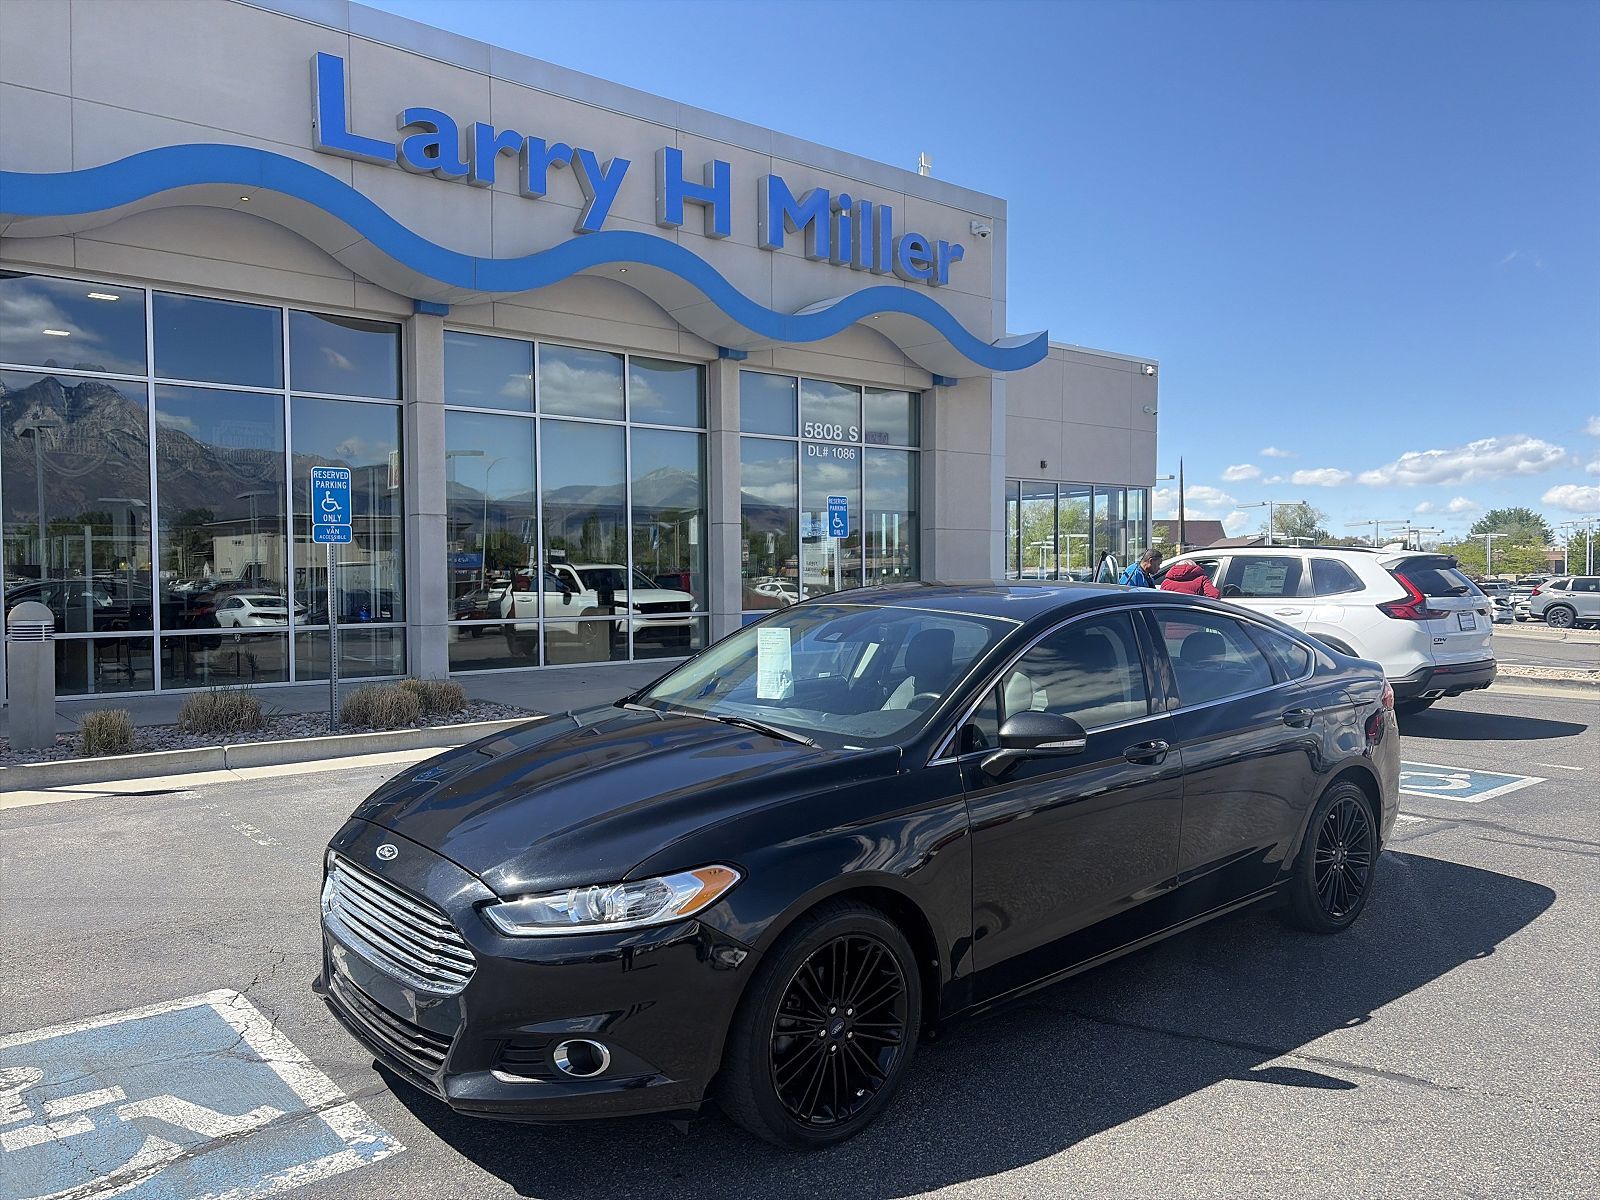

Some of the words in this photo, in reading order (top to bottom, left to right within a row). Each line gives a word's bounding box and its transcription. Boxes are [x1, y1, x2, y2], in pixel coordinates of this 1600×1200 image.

[311, 52, 631, 234] Larry
[655, 146, 732, 240] H
[757, 173, 965, 288] Miller
[804, 421, 843, 441] 5808
[848, 425, 859, 442] S
[807, 444, 829, 458] DL#
[832, 446, 856, 460] 1086
[313, 470, 349, 480] RESERVED
[315, 480, 347, 489] PARKING
[323, 514, 342, 523] ONLY
